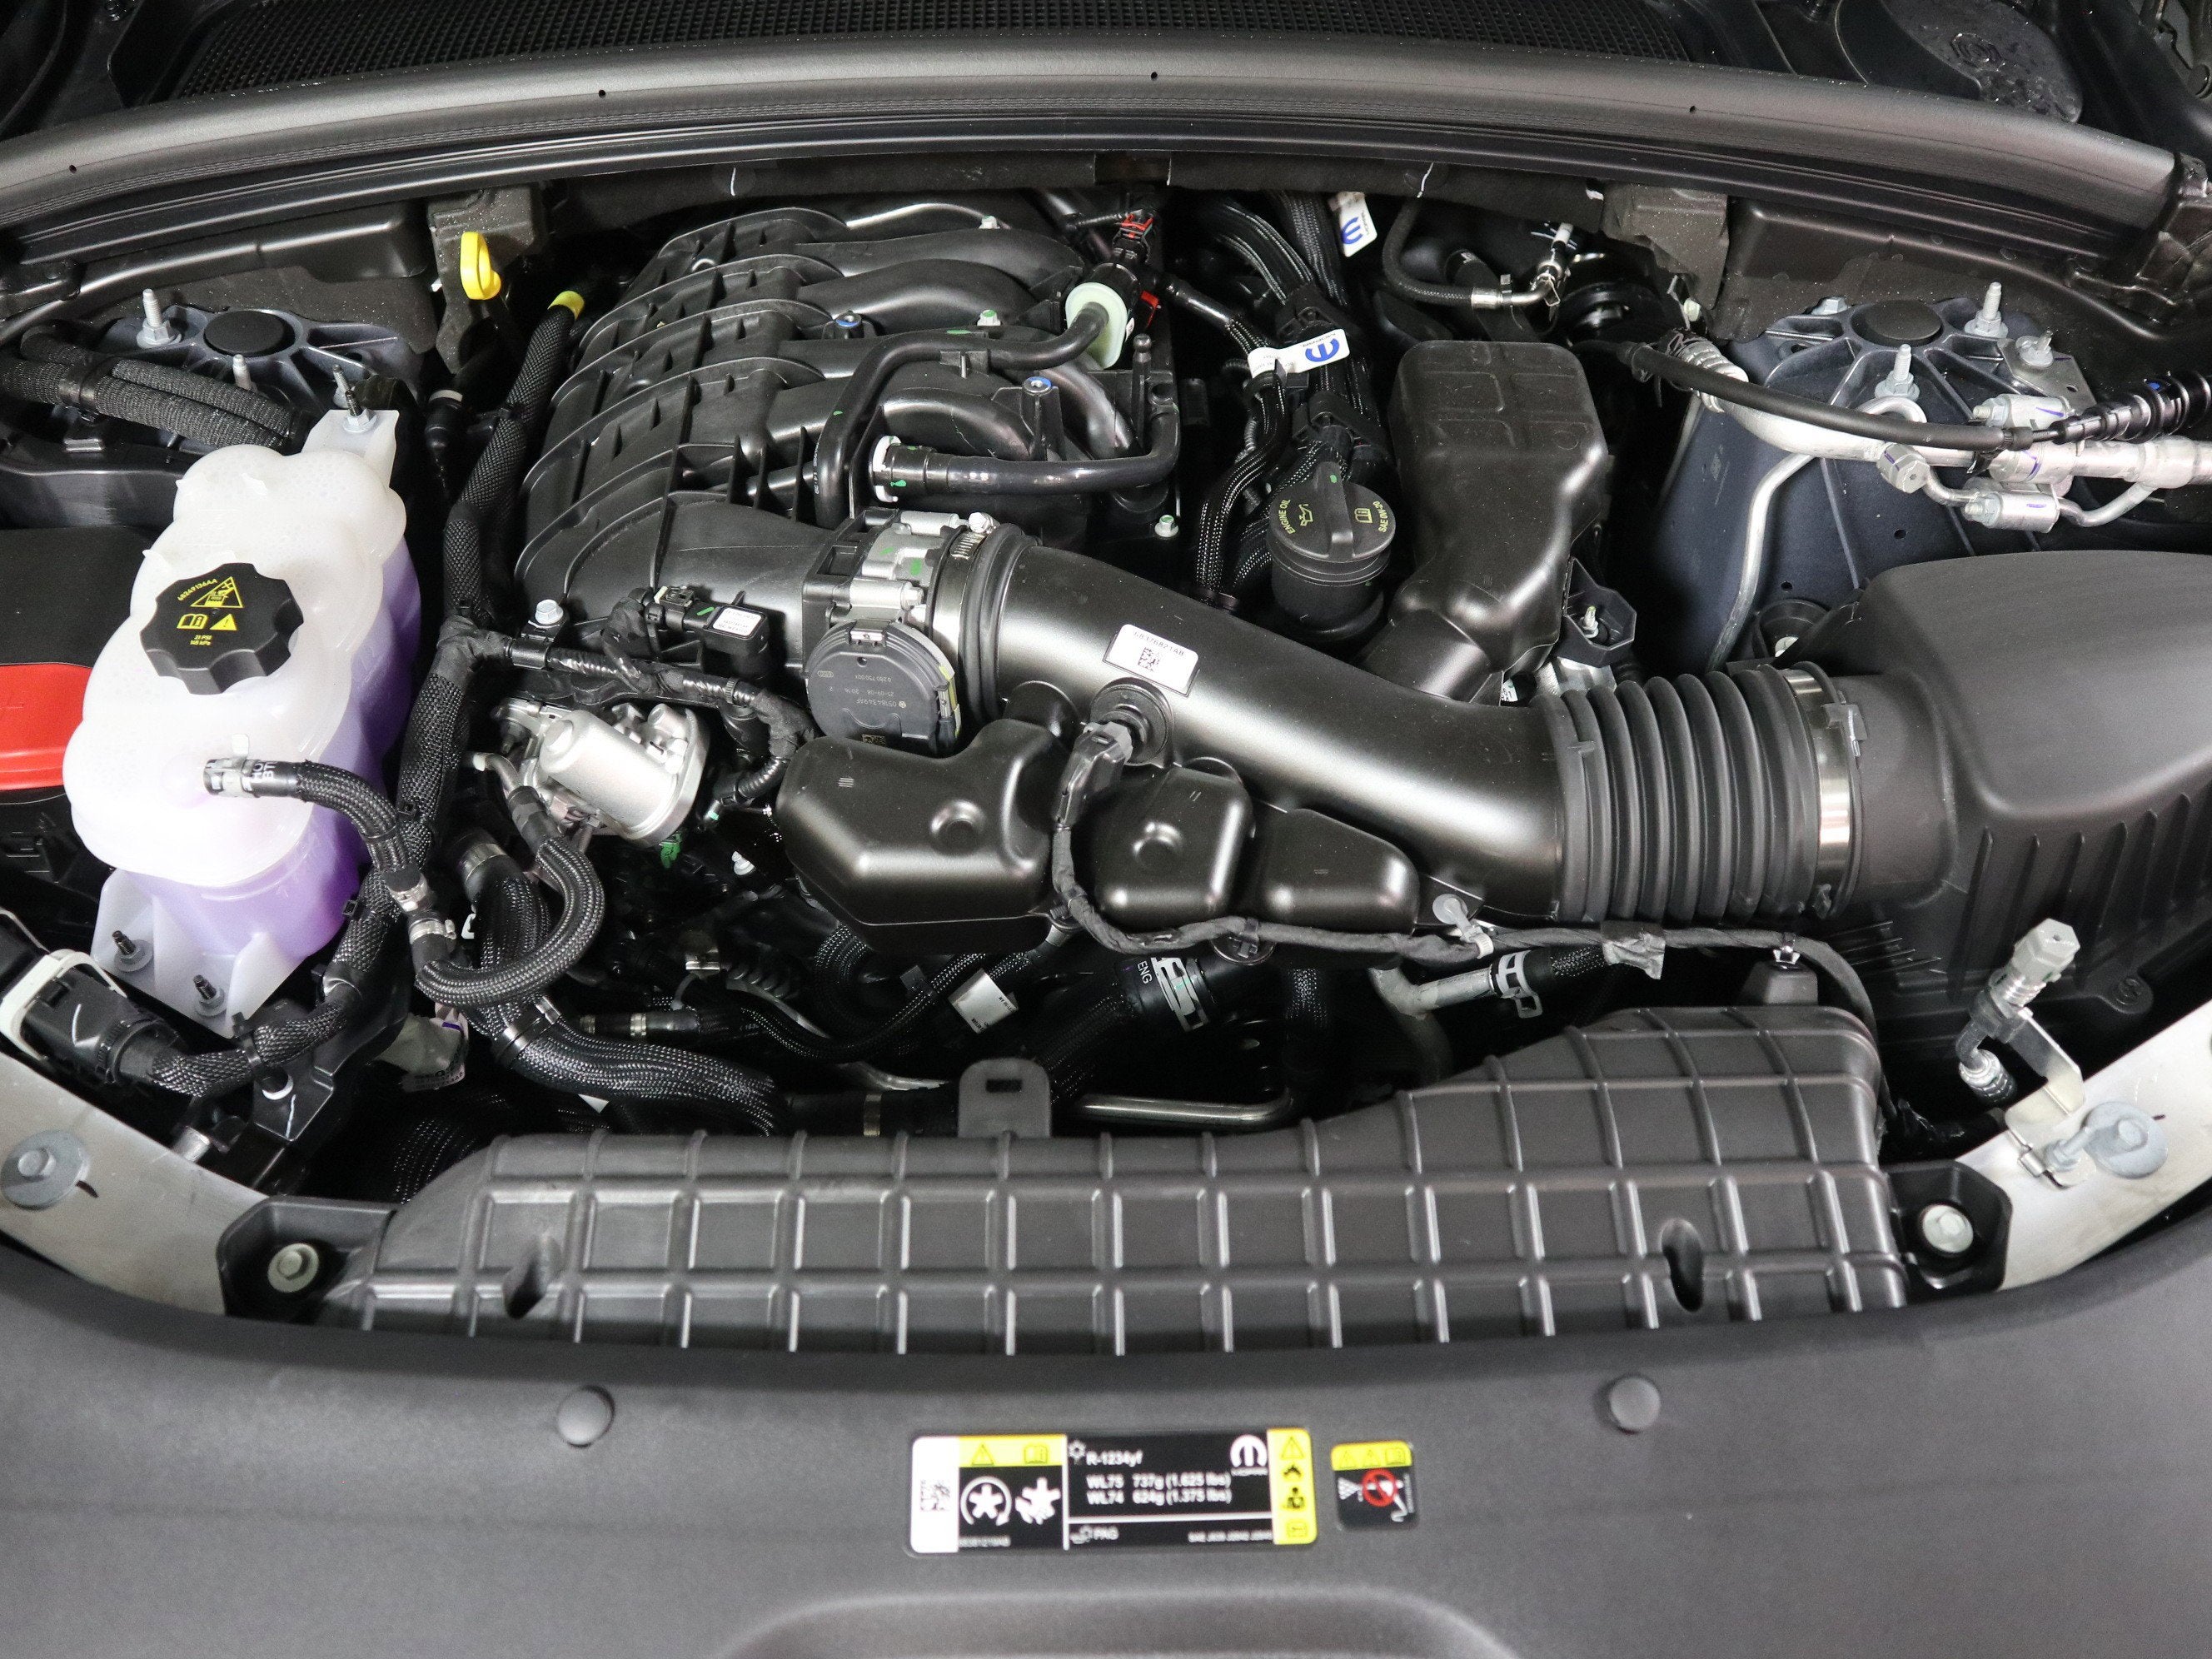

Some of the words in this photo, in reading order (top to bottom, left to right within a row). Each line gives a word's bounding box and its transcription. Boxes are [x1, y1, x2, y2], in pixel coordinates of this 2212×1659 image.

[1279, 499, 1291, 510] OIL
[1278, 510, 1296, 535] ENGINE
[1378, 518, 1389, 533] SAE
[1137, 960, 1153, 984] ENG
[1085, 1449, 1143, 1467] R-1234yf
[1132, 1472, 1164, 1491] 737g
[1206, 1470, 1232, 1487] lbs)
[1086, 1490, 1124, 1505] WL74
[1166, 1487, 1206, 1506] (1.375
[1206, 1487, 1233, 1505] lbs)
